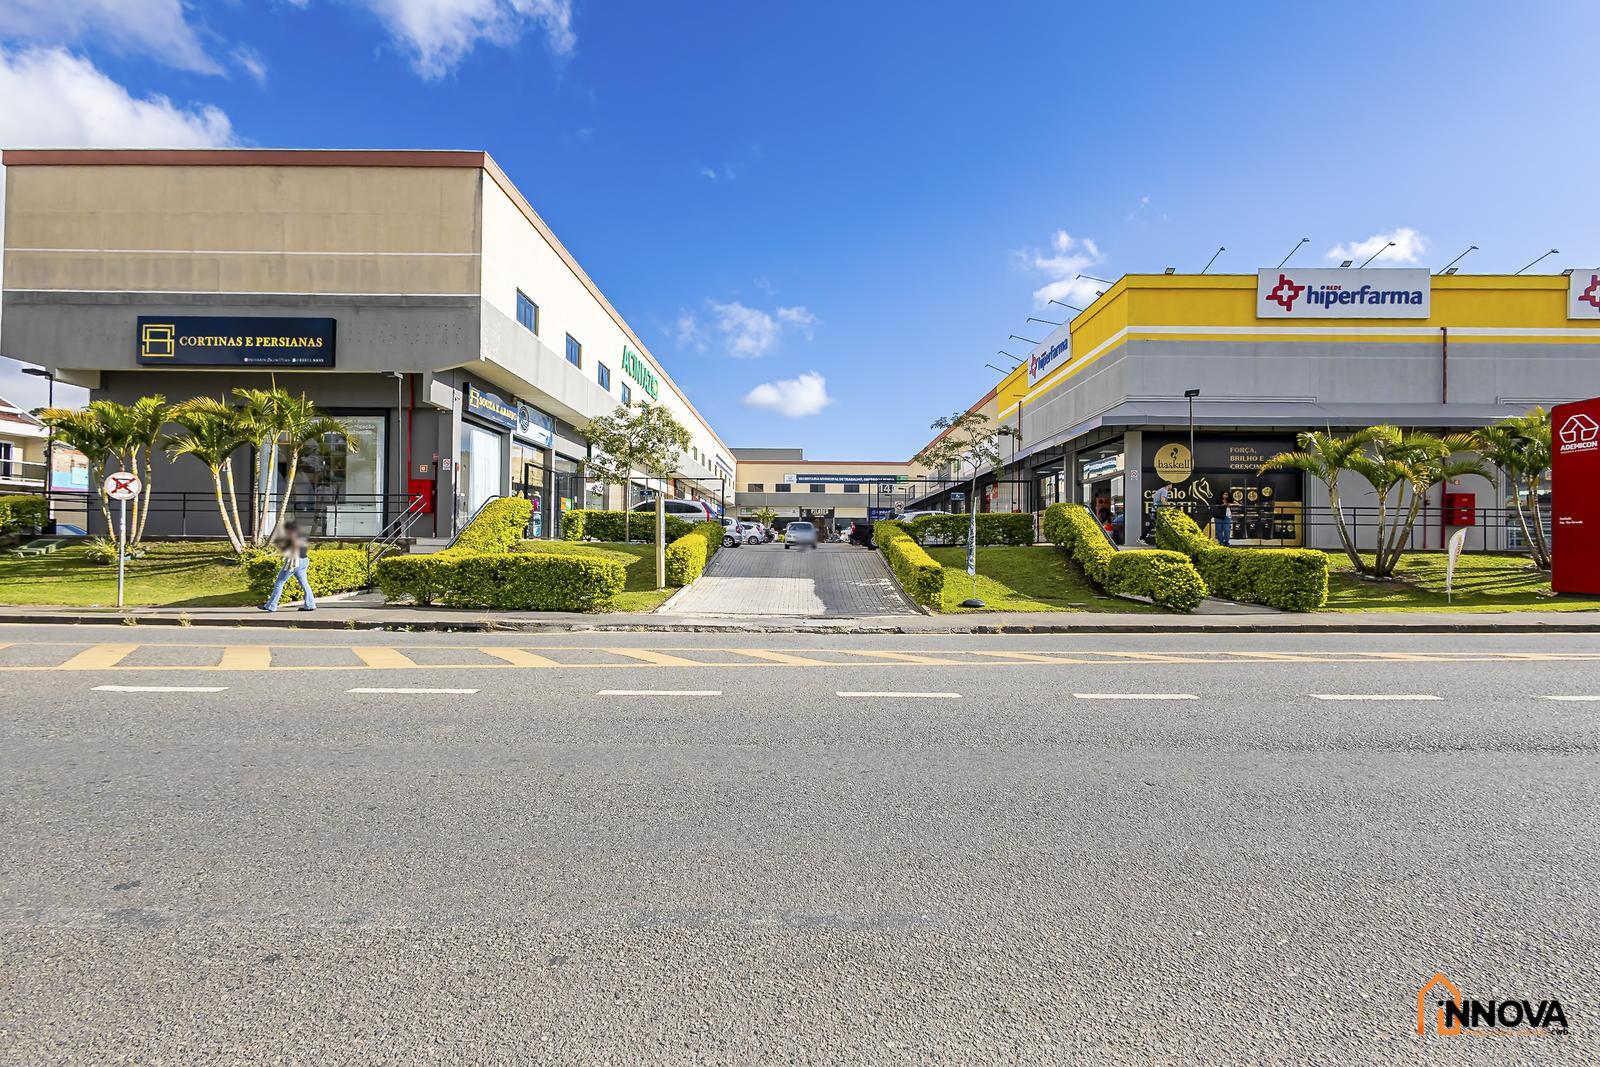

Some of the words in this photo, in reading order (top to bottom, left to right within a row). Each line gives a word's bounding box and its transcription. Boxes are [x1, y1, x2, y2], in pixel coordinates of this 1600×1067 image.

[1306, 285, 1422, 309] hiperfarma
[179, 336, 242, 346] CORTINAS
[245, 337, 253, 346] E
[255, 337, 323, 348] PERSIANAS
[1037, 338, 1068, 371] hiperfarma
[1560, 441, 1598, 451] ADEMICON
[1144, 487, 1186, 499] caalo
